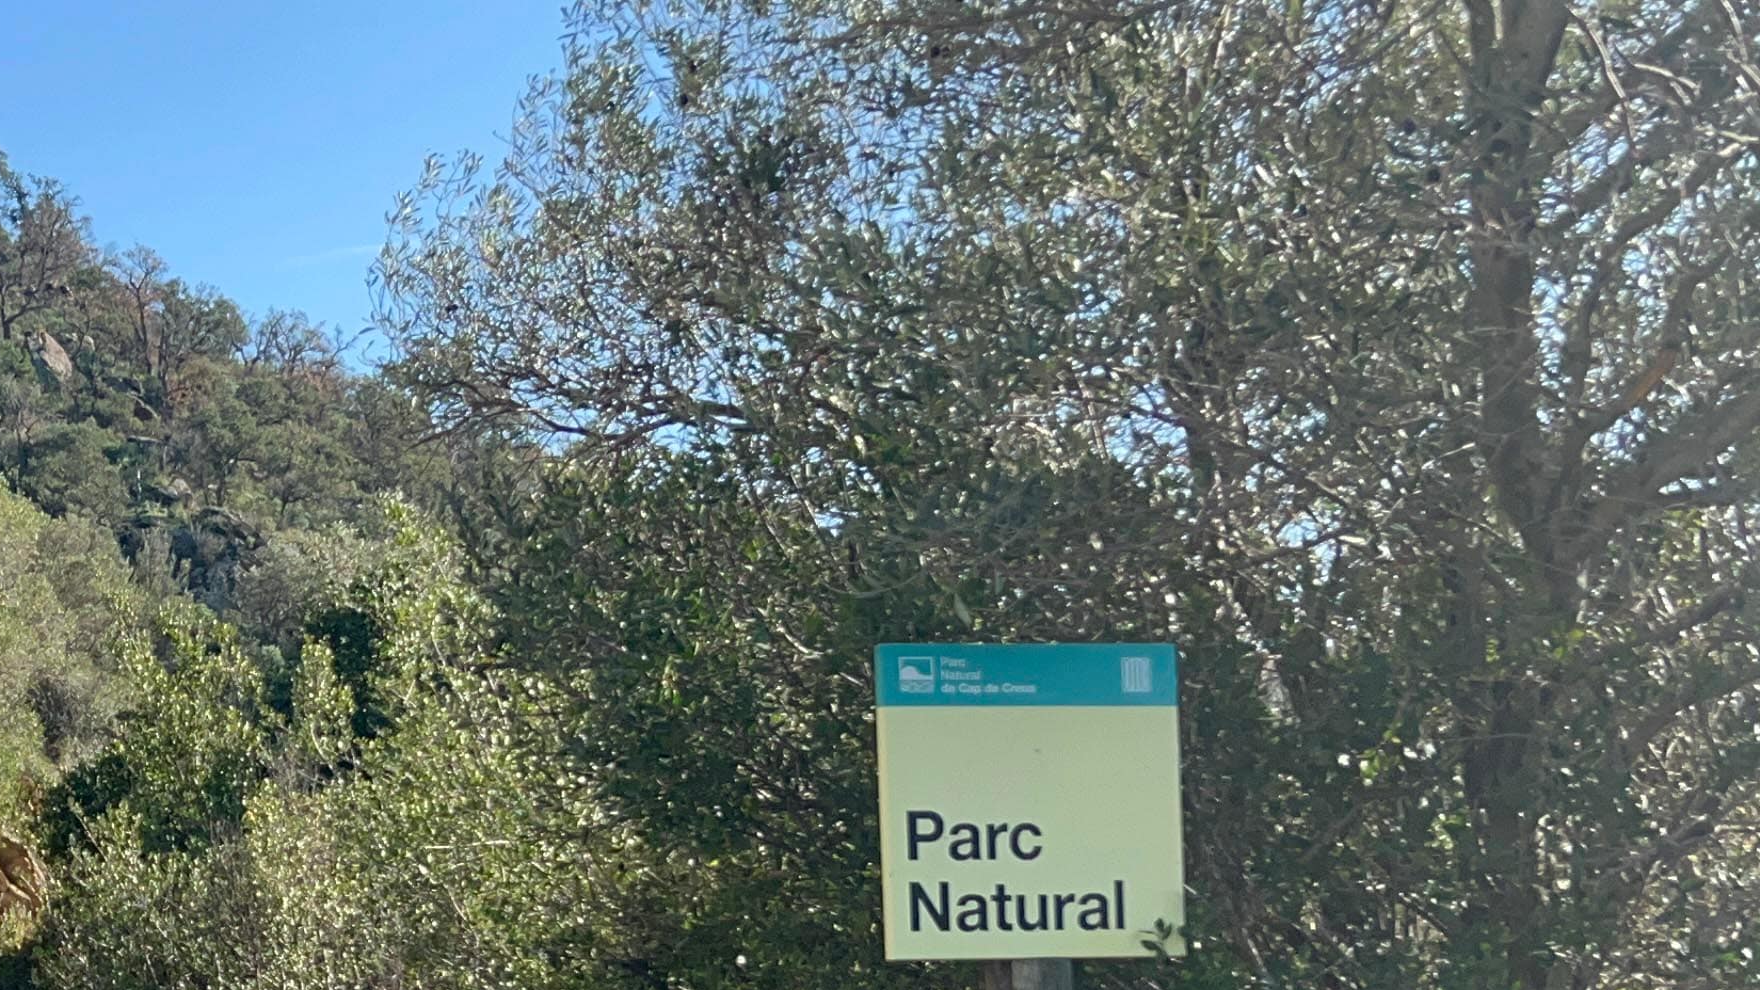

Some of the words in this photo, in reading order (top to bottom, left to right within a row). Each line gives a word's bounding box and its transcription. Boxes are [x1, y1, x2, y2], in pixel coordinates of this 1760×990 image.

[940, 656, 966, 668] Parc
[940, 670, 981, 681] Natural
[906, 810, 1043, 861] Parc
[909, 879, 1125, 933] Natural
